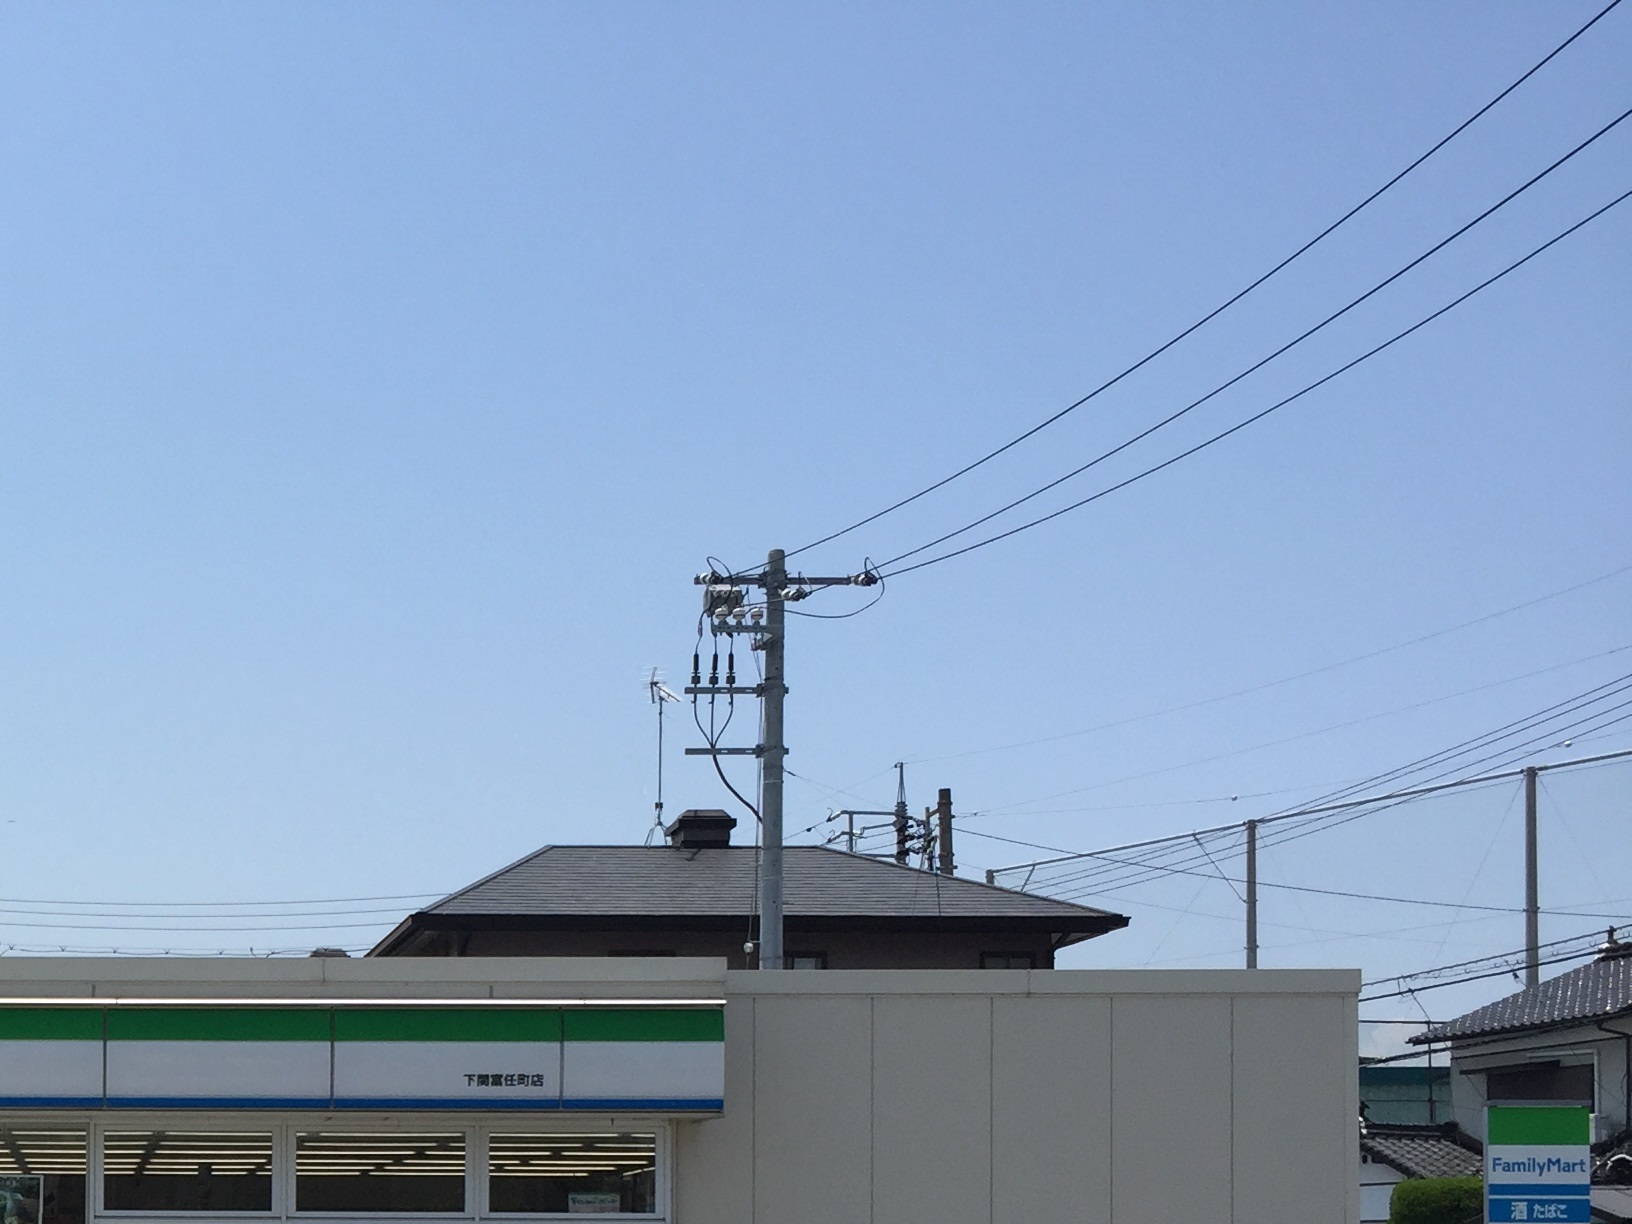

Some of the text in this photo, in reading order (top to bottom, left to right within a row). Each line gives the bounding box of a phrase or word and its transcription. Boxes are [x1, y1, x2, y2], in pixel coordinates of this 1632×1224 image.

[463, 1073, 544, 1087] 下関富任町店
[1492, 1157, 1586, 1177] FamilyMart
[1510, 1201, 1568, 1220] 酒 たばこ
